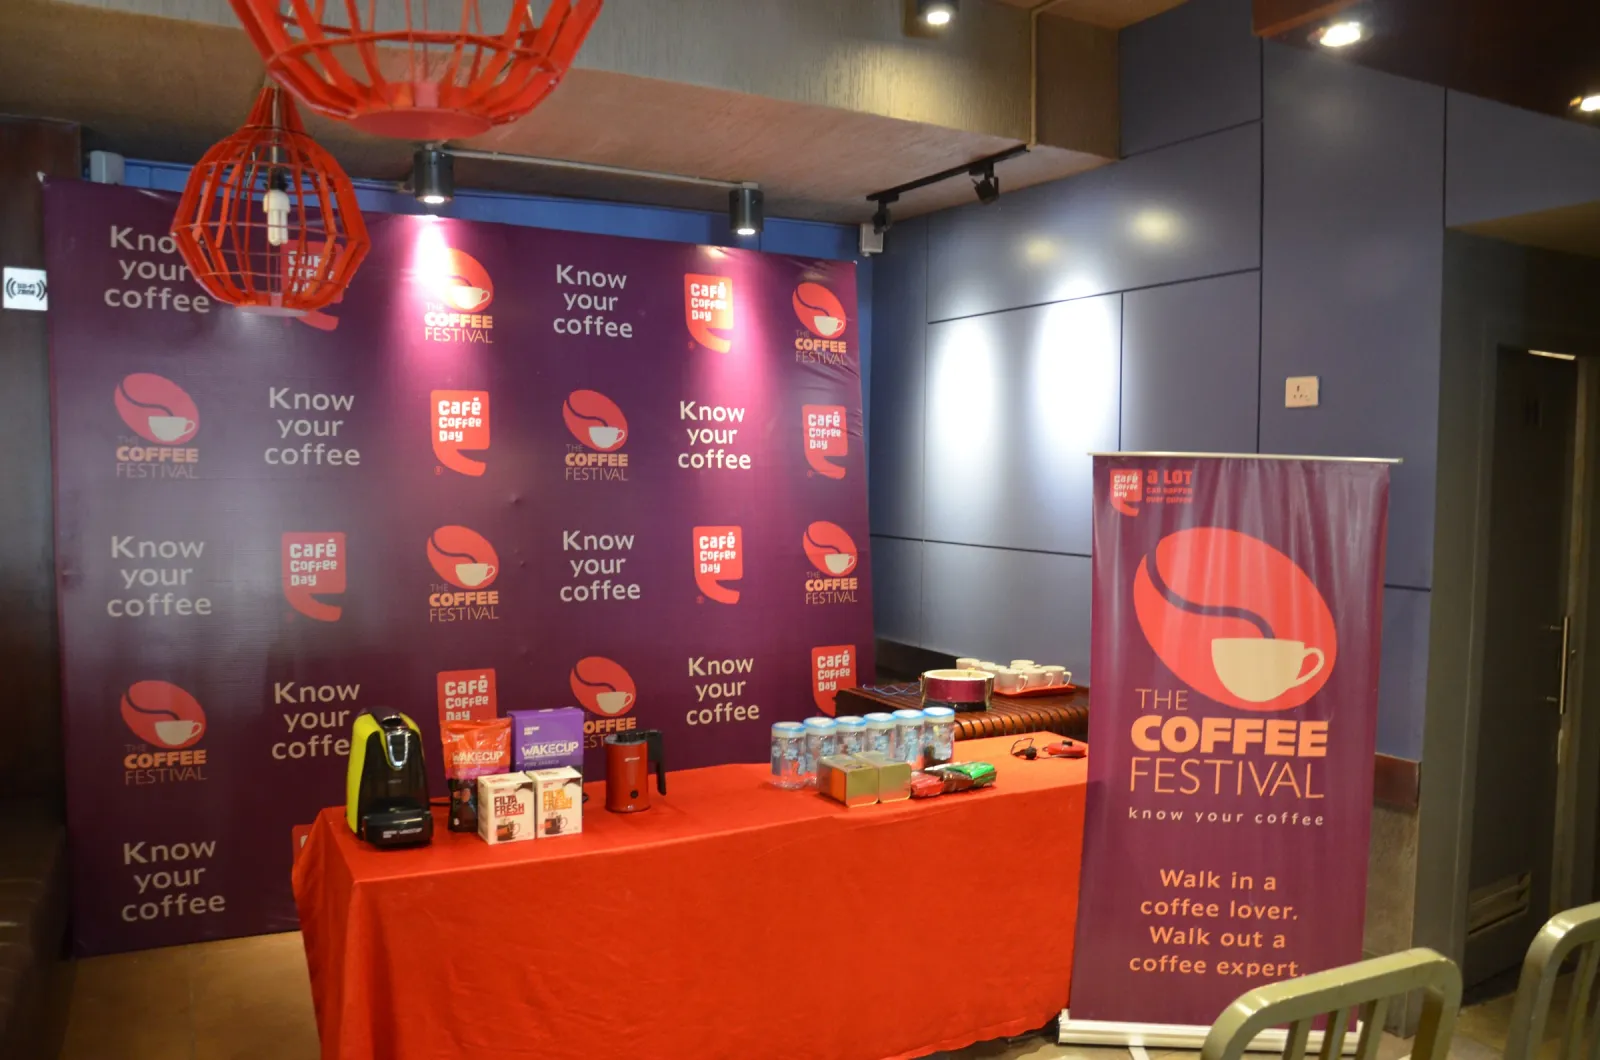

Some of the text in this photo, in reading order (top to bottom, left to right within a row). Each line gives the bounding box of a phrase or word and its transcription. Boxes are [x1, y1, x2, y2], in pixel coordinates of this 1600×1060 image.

[110, 225, 177, 254] Kno
[556, 264, 627, 289] Know
[104, 286, 210, 313] coffee
[564, 293, 618, 311] your
[424, 312, 493, 328] COFFEE
[692, 310, 712, 321] Day
[425, 327, 493, 343] FESTIVAL
[553, 315, 633, 338] coffee
[795, 338, 847, 353] COFFEE
[795, 352, 847, 365] FESTIVAL
[269, 387, 354, 411] Know
[679, 401, 745, 422] Know
[277, 420, 343, 438] your
[439, 431, 463, 442] Day
[687, 427, 738, 445] your
[810, 439, 828, 449] Day
[116, 446, 199, 462] COFFEE
[264, 444, 361, 466] coffee
[565, 453, 628, 466] COFFEE
[678, 450, 751, 469] coffee
[116, 463, 200, 479] FESTIVAL
[565, 467, 628, 481] FESTIVAL
[1163, 469, 1192, 485] LOT
[111, 535, 204, 559] Know
[563, 530, 635, 551] Know
[570, 557, 626, 577] your
[700, 563, 720, 574] Day
[806, 571, 820, 579] THE
[121, 567, 193, 589] your
[291, 574, 317, 586] Day
[430, 583, 449, 592] THE
[805, 577, 857, 592] COFFEE
[429, 591, 499, 607] COFFEE
[560, 580, 641, 602] coffee
[806, 591, 858, 605] FESTIVAL
[107, 593, 212, 617] coffee
[429, 606, 499, 622] FESTIVAL
[688, 656, 754, 676] Know
[274, 682, 360, 704] Know
[695, 681, 746, 702] your
[818, 680, 837, 692] Day
[1135, 688, 1188, 710] THE
[283, 709, 349, 733] your
[686, 703, 760, 725] coffee
[583, 717, 636, 734] OFFEE
[1131, 715, 1328, 757] COFFEE
[272, 735, 350, 760] coffe
[521, 741, 579, 757] WAKECUP
[124, 750, 207, 769] COFFEE
[125, 768, 207, 786] FESTIVAL
[1130, 757, 1325, 799] FESTIVAL
[494, 794, 517, 805] FILTA
[494, 803, 525, 816] FRESH
[1128, 806, 1324, 826] know your coffee
[123, 840, 216, 865] Know
[134, 868, 206, 894] your
[1160, 868, 1276, 890] Walk in a
[121, 894, 226, 922] coffee
[1140, 898, 1298, 920] coffee lover.
[1149, 926, 1286, 949] Walk out a
[1129, 955, 1207, 974] coffee
